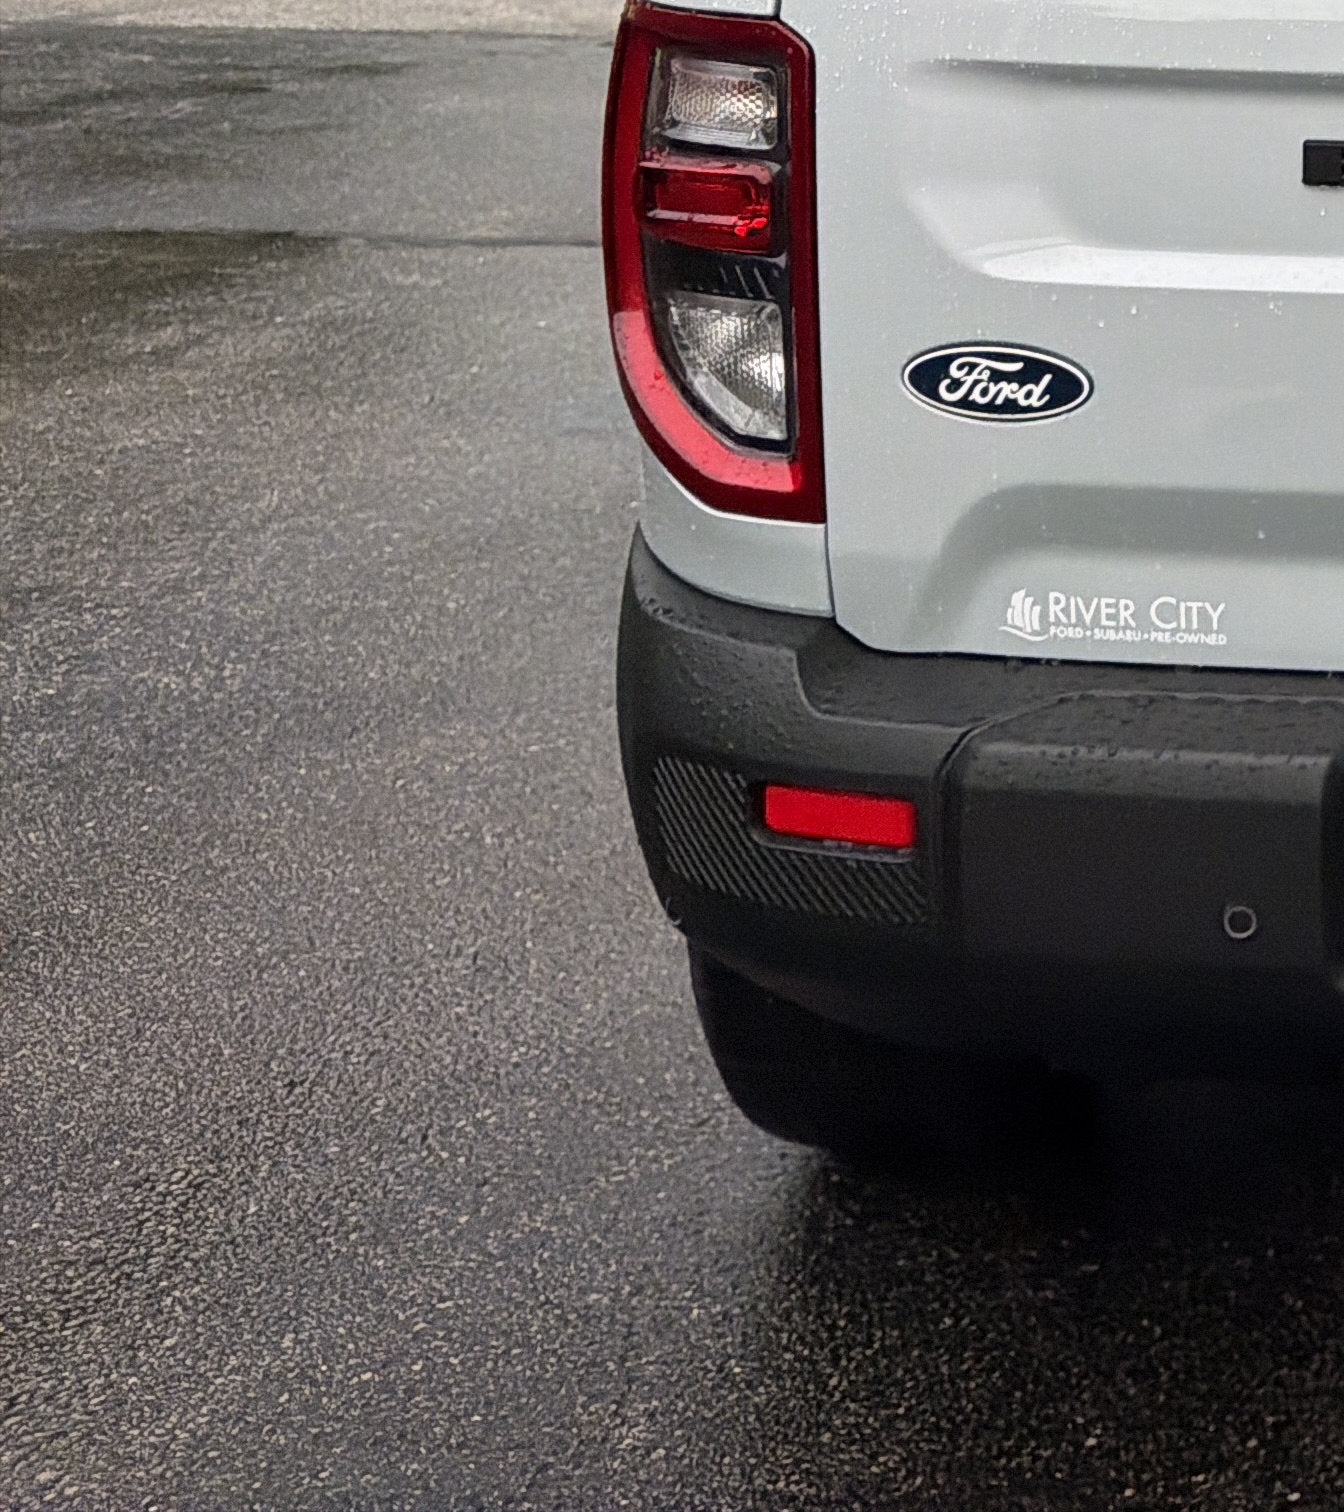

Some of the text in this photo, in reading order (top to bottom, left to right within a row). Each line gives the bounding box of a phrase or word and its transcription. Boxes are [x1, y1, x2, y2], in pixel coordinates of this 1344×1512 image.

[938, 356, 1052, 407] Ford
[1049, 591, 1226, 631] RIVER CITY
[1050, 626, 1227, 645] FORD SUBARU PRE-OWNED
